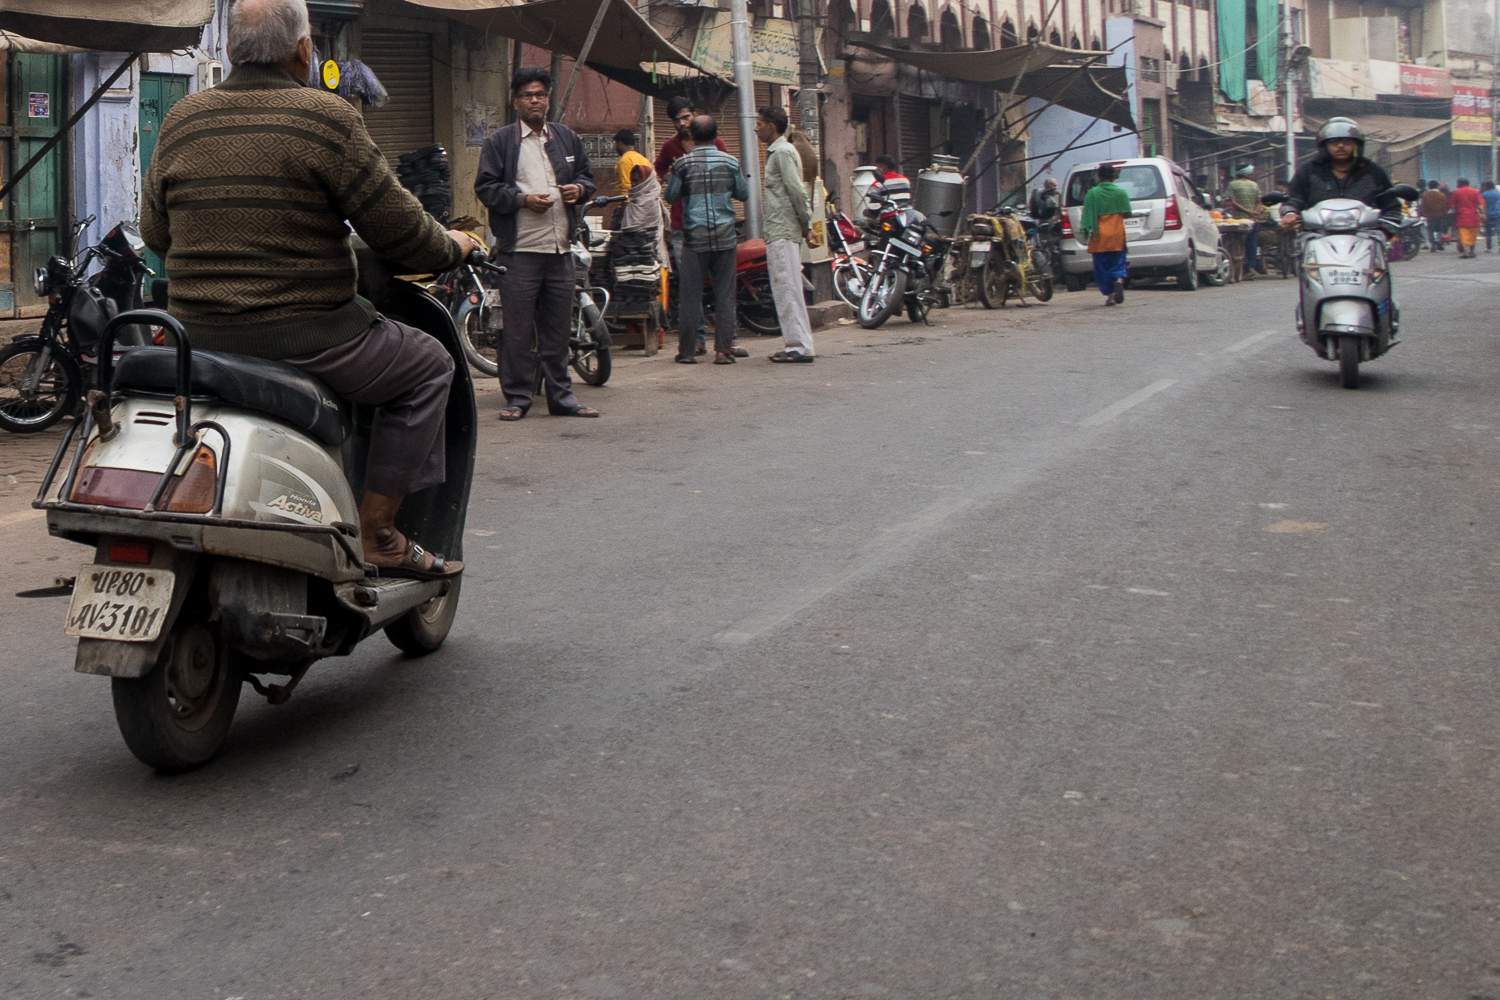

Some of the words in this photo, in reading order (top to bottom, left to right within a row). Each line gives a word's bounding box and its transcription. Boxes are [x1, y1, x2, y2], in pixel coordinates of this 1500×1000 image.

[266, 494, 323, 524] Activa
[290, 493, 316, 506] Honda
[94, 570, 146, 596] UP-80
[70, 600, 160, 636] AV-3101
